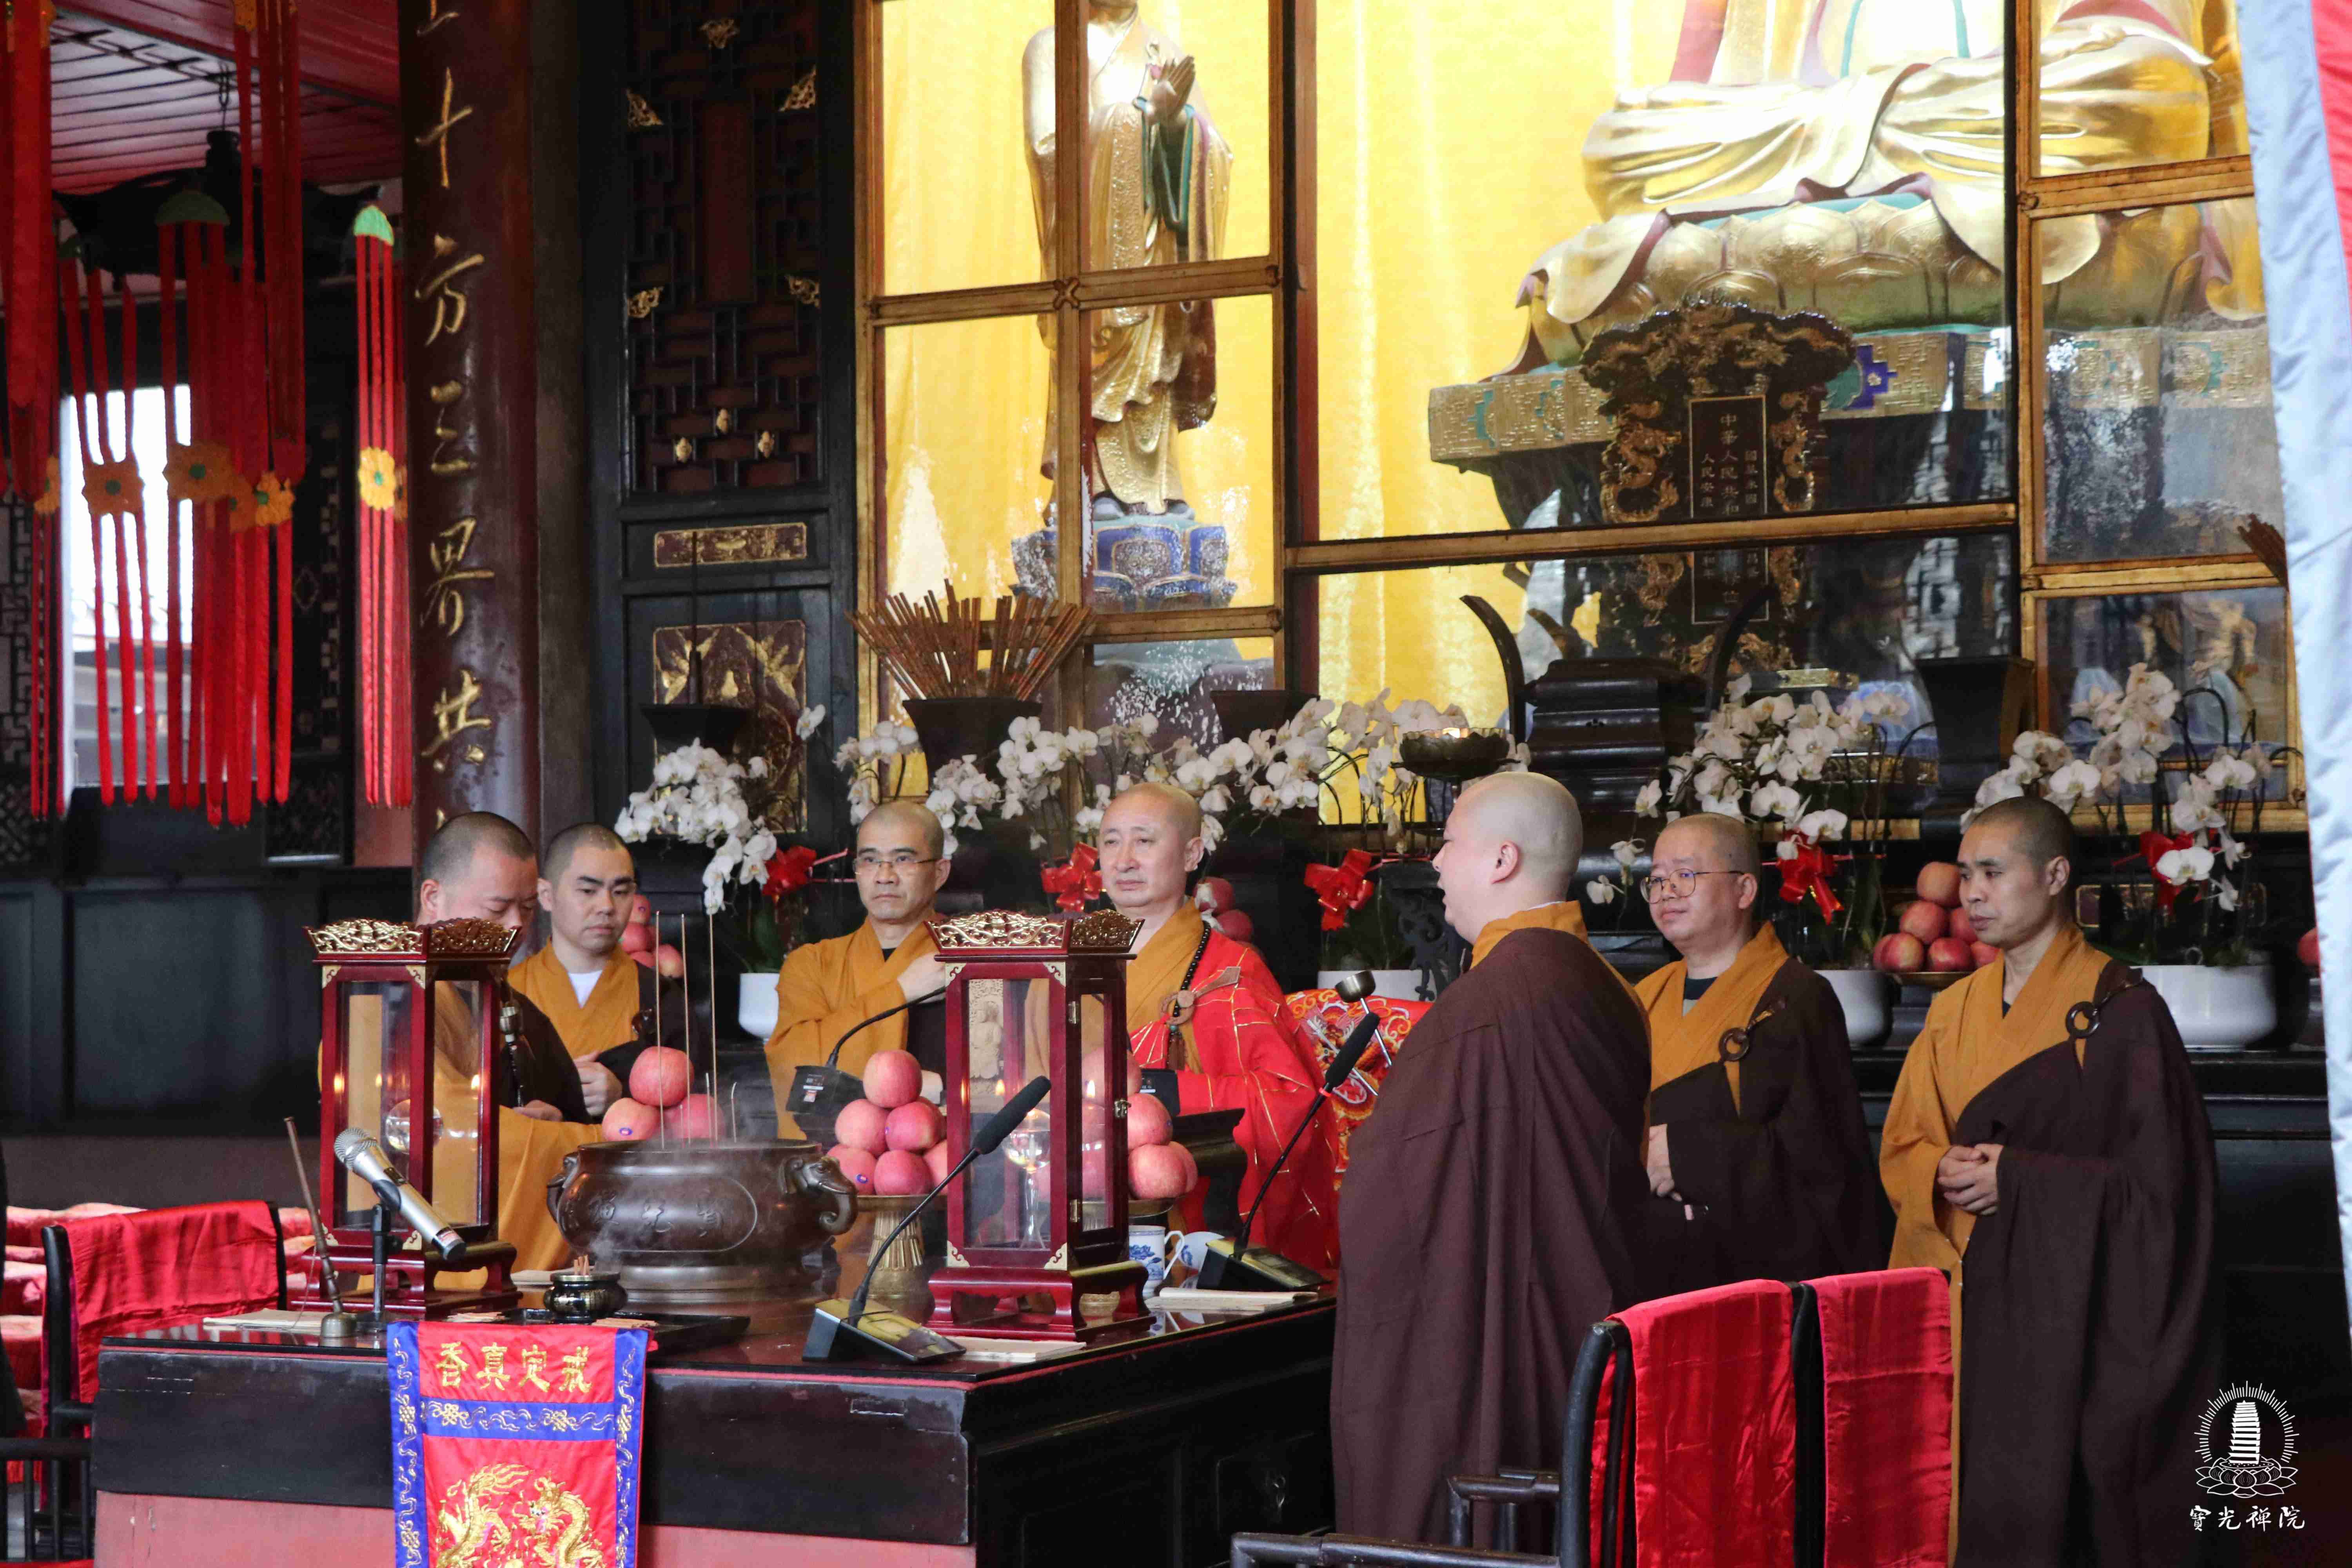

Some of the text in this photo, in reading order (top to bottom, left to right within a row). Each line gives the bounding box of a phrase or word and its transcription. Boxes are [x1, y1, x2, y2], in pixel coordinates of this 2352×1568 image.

[417, 0, 495, 828] 十方三界共
